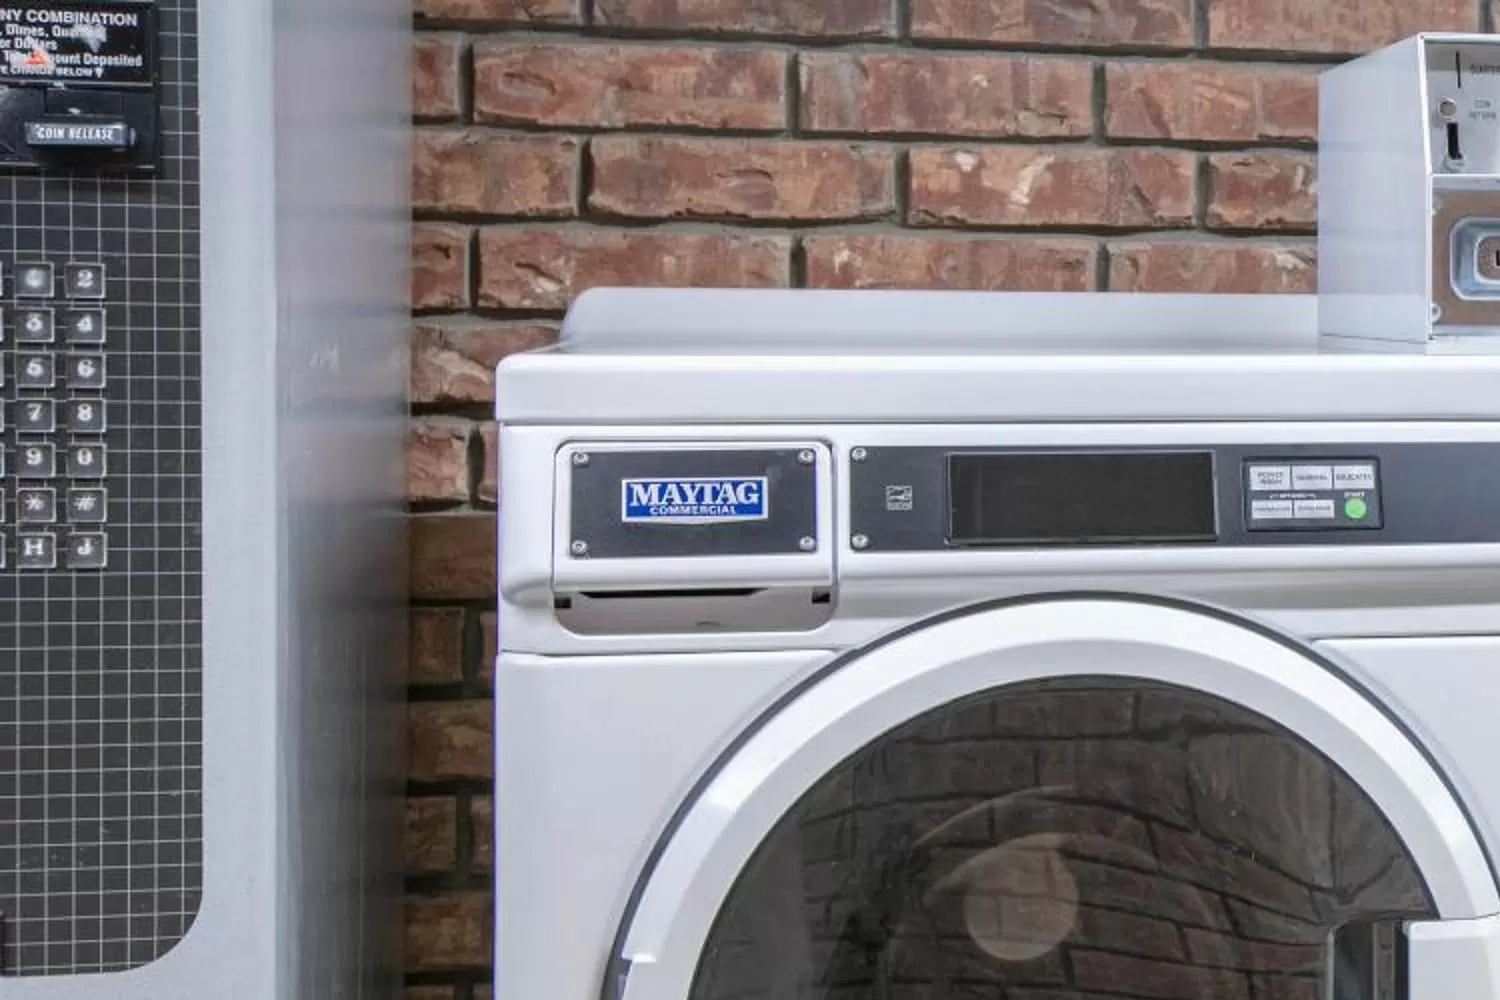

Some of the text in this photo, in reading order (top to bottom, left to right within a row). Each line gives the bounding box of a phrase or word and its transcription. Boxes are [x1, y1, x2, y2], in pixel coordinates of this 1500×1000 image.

[0, 8, 137, 26] NY COMBINATION
[83, 53, 143, 67] Deposited
[77, 269, 94, 288] 2
[76, 314, 93, 333] 4
[77, 359, 95, 378] 6
[27, 403, 93, 421] 7 8
[26, 448, 42, 465] 9
[629, 482, 759, 507] MAYTAG
[650, 504, 737, 516] COMMERCIAL
[24, 537, 44, 556] H
